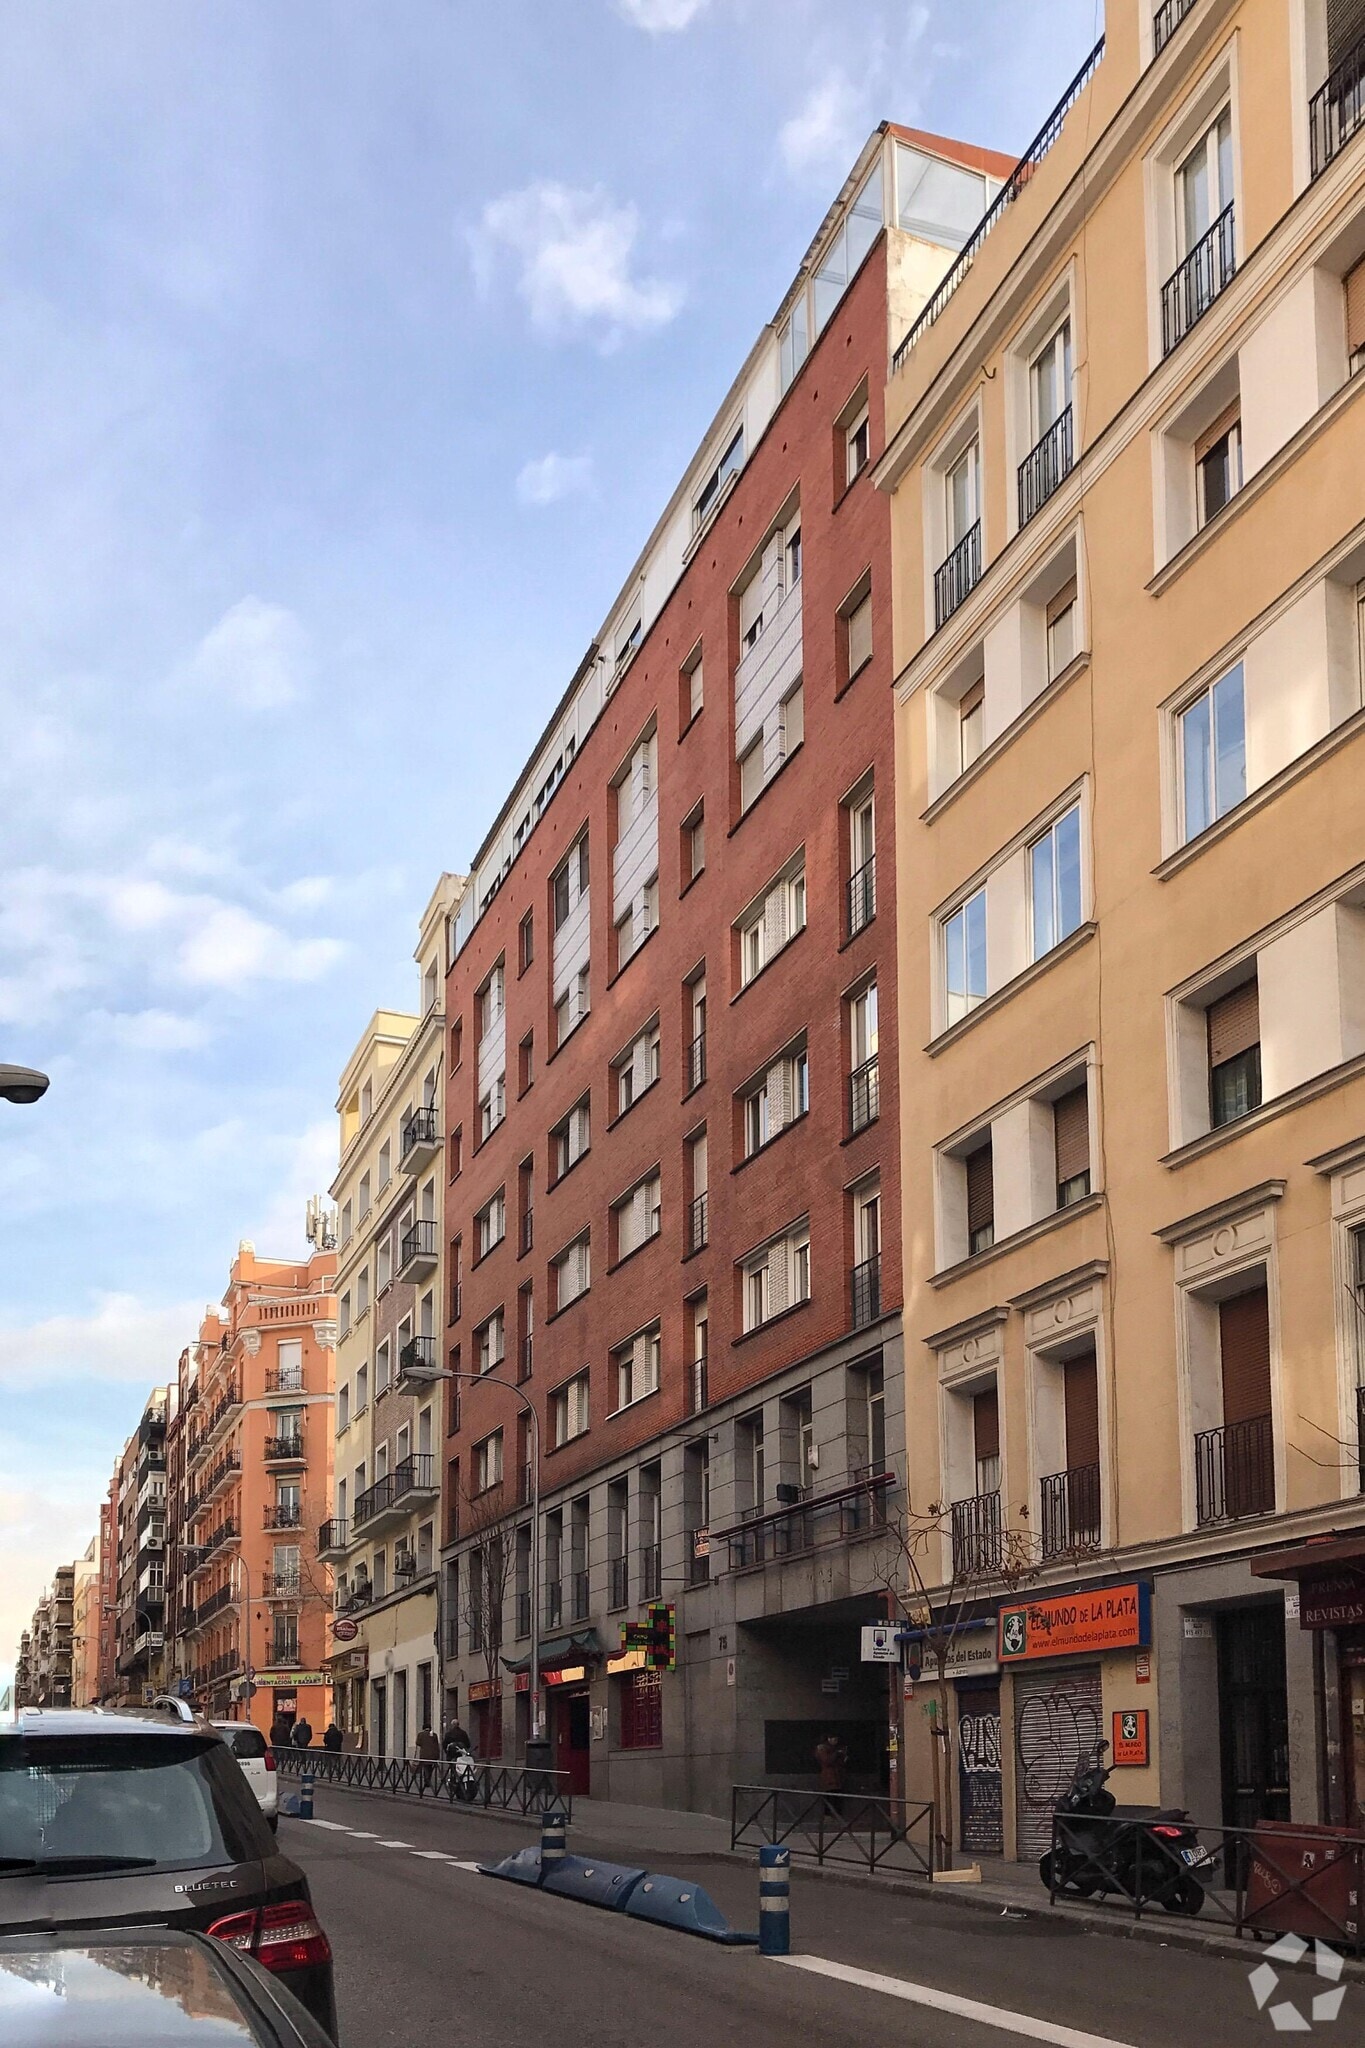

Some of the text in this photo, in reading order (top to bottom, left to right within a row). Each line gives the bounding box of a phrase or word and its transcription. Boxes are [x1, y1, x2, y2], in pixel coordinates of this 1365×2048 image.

[1080, 1609, 1089, 1624] DE
[1091, 1602, 1103, 1620] LA
[1106, 1597, 1137, 1619] PLATA
[1306, 1603, 1364, 1623] REVISTAS
[719, 1635, 728, 1651] 75
[956, 1651, 967, 1663] del
[967, 1647, 992, 1661] Estado
[174, 1881, 238, 1893] BLUETEC
